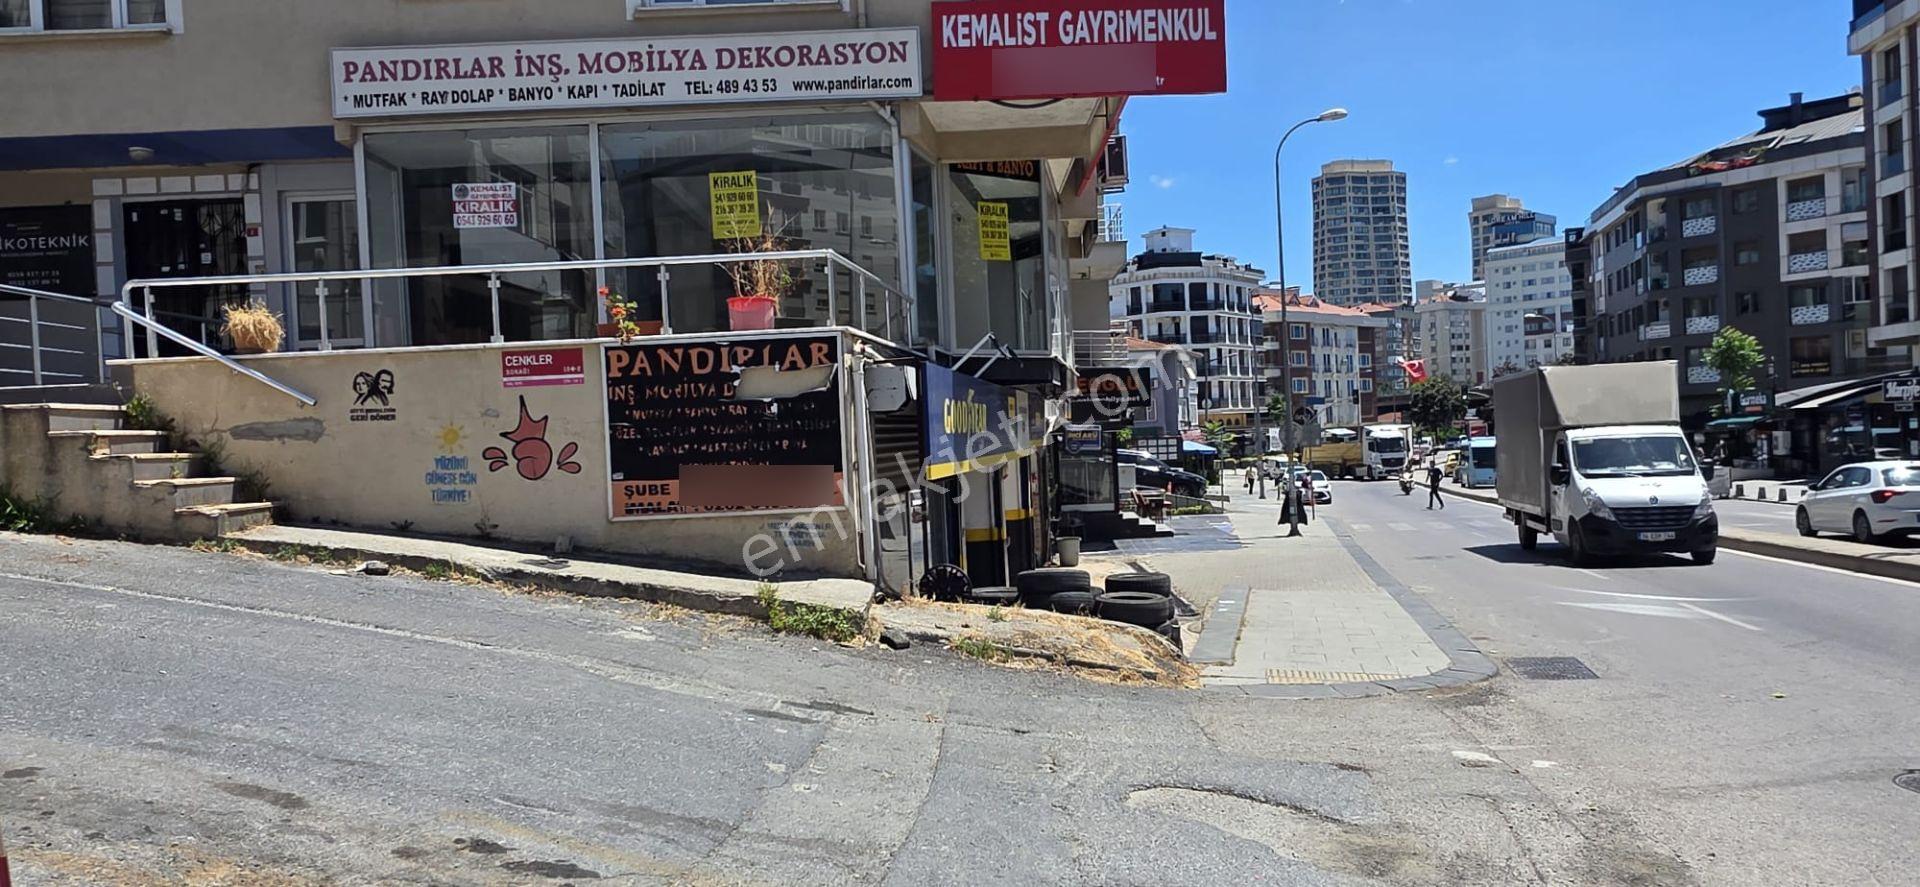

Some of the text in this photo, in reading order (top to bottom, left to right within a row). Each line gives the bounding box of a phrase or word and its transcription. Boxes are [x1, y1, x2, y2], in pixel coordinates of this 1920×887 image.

[942, 8, 1217, 47] KEMALİST GAYRİMENKUL
[342, 40, 909, 83] PANDIRLAR İNŞ. MOBİLYA DEKORASYON
[353, 92, 407, 108] MUTFAK
[451, 88, 494, 104] DOLAP
[508, 86, 553, 101] BANYO
[567, 84, 598, 99] KAPI
[612, 80, 666, 97] TADİLAT
[685, 81, 713, 95] TEL:
[716, 80, 739, 94] 489
[743, 79, 758, 92] 43
[762, 78, 777, 92] 53
[792, 75, 913, 93] www.pandirlar.com
[713, 174, 754, 189] KİRALIK
[455, 200, 514, 213] KİRALIK
[504, 214, 514, 225] 60
[505, 354, 553, 366] CENKLER
[944, 397, 987, 434] GOODYEAR
[624, 483, 671, 499] ŞUBE
